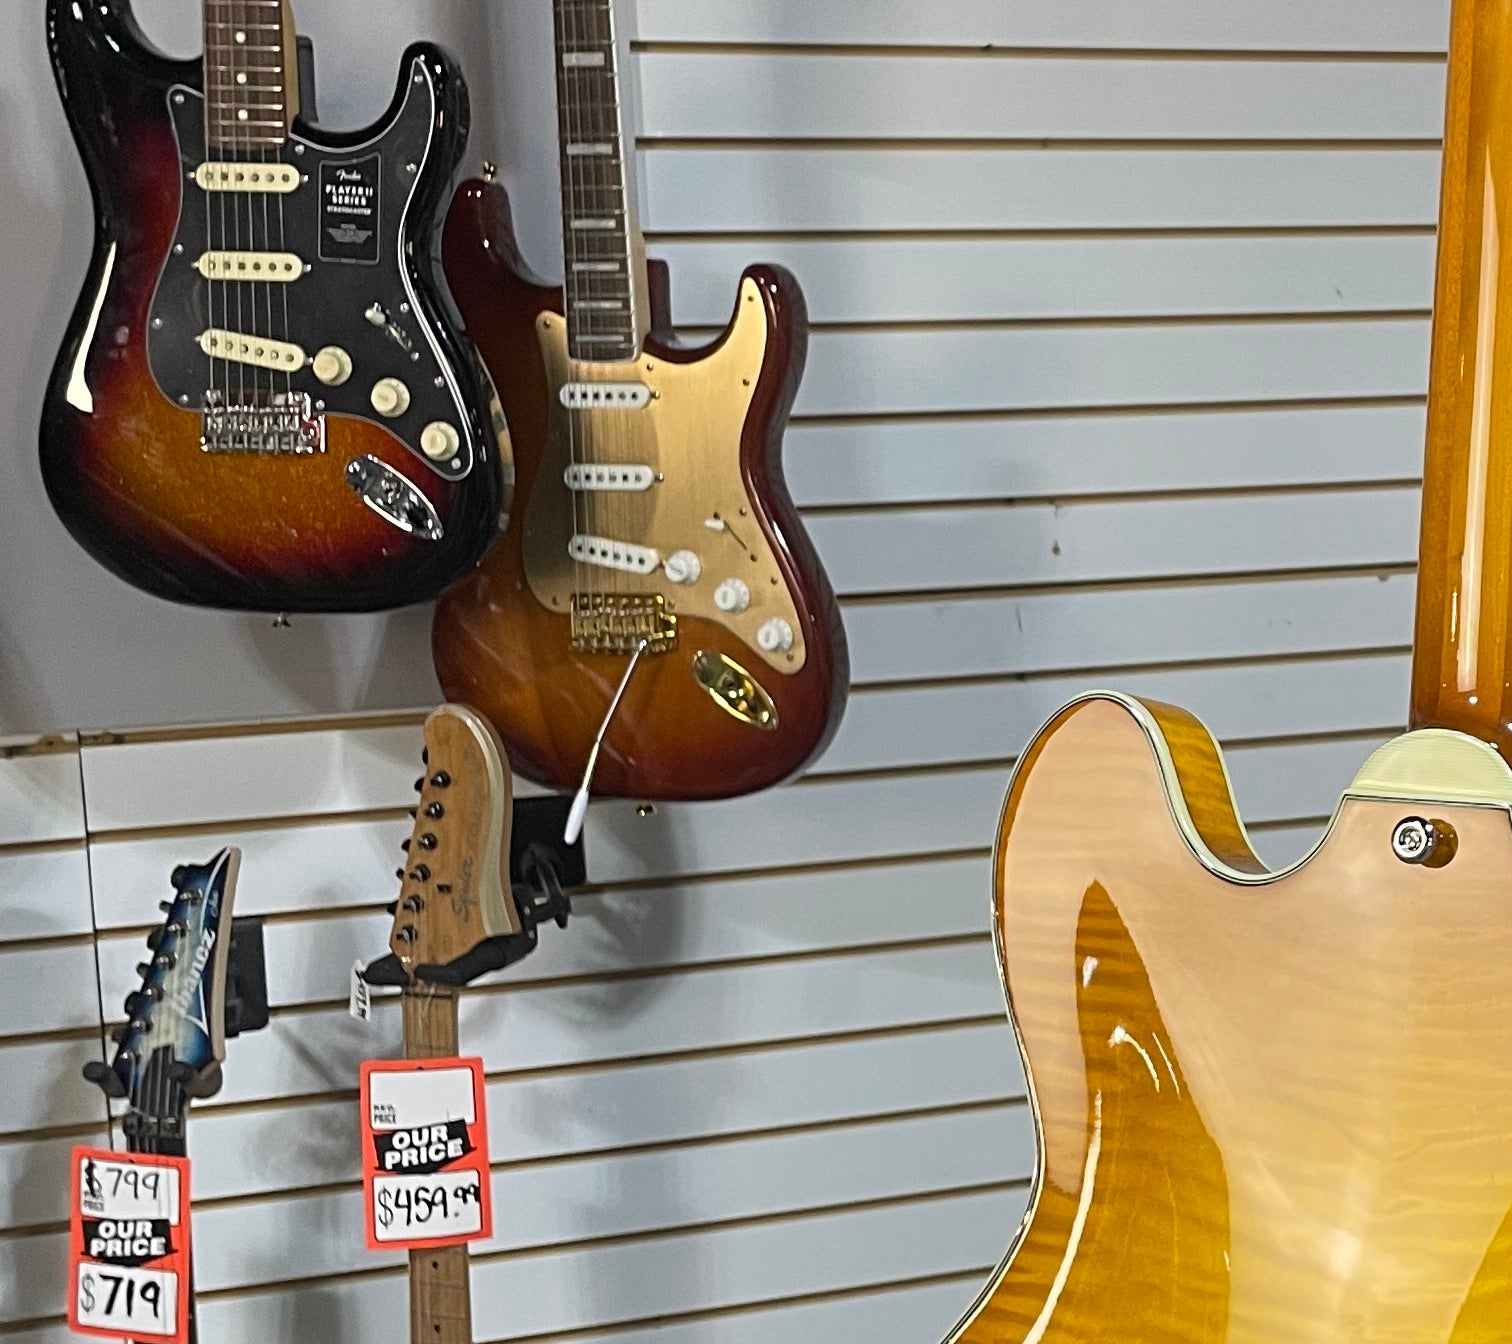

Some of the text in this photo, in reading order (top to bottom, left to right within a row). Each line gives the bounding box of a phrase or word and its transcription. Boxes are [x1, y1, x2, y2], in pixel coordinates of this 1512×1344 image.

[392, 1124, 449, 1150] OUR
[385, 1137, 464, 1171] PRICE
[99, 1220, 153, 1239] OUR
[90, 1236, 166, 1257] PRICE
[81, 1272, 161, 1319] $719
